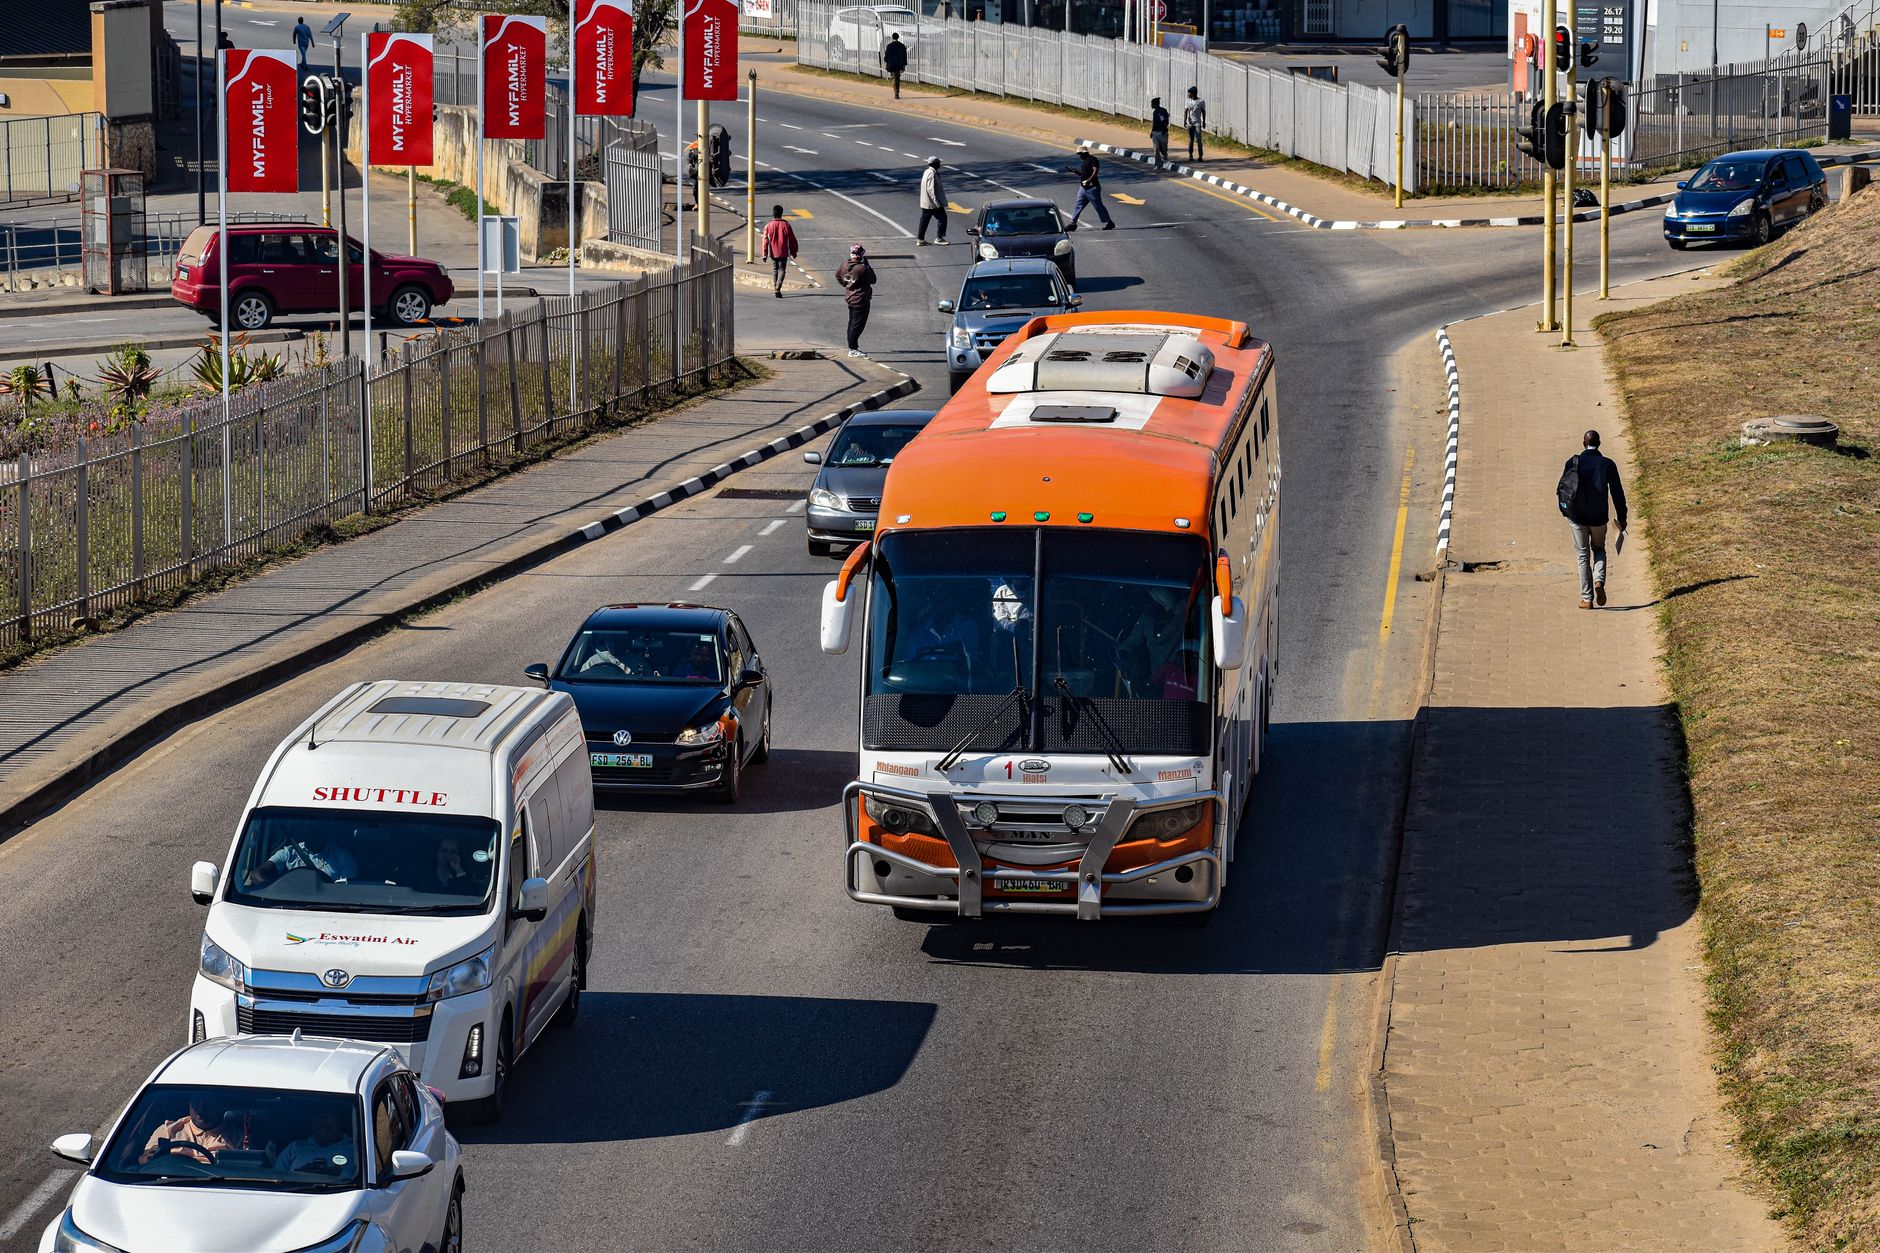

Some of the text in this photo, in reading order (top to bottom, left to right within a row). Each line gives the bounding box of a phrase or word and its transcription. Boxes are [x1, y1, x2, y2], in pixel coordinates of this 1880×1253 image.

[1604, 7, 1622, 15] 26.17
[1604, 26, 1622, 34] 29.20
[266, 83, 274, 108] Liquor
[405, 64, 413, 125] HYPERMARKET
[592, 755, 651, 766] FSD 256 BL
[876, 761, 919, 776] Nhlangano
[1004, 761, 1013, 779] 1
[1158, 768, 1192, 780] Manzini
[313, 787, 448, 806] SHUTTLE
[1010, 831, 1051, 839] MAN
[319, 932, 418, 945] Eswatini Air
